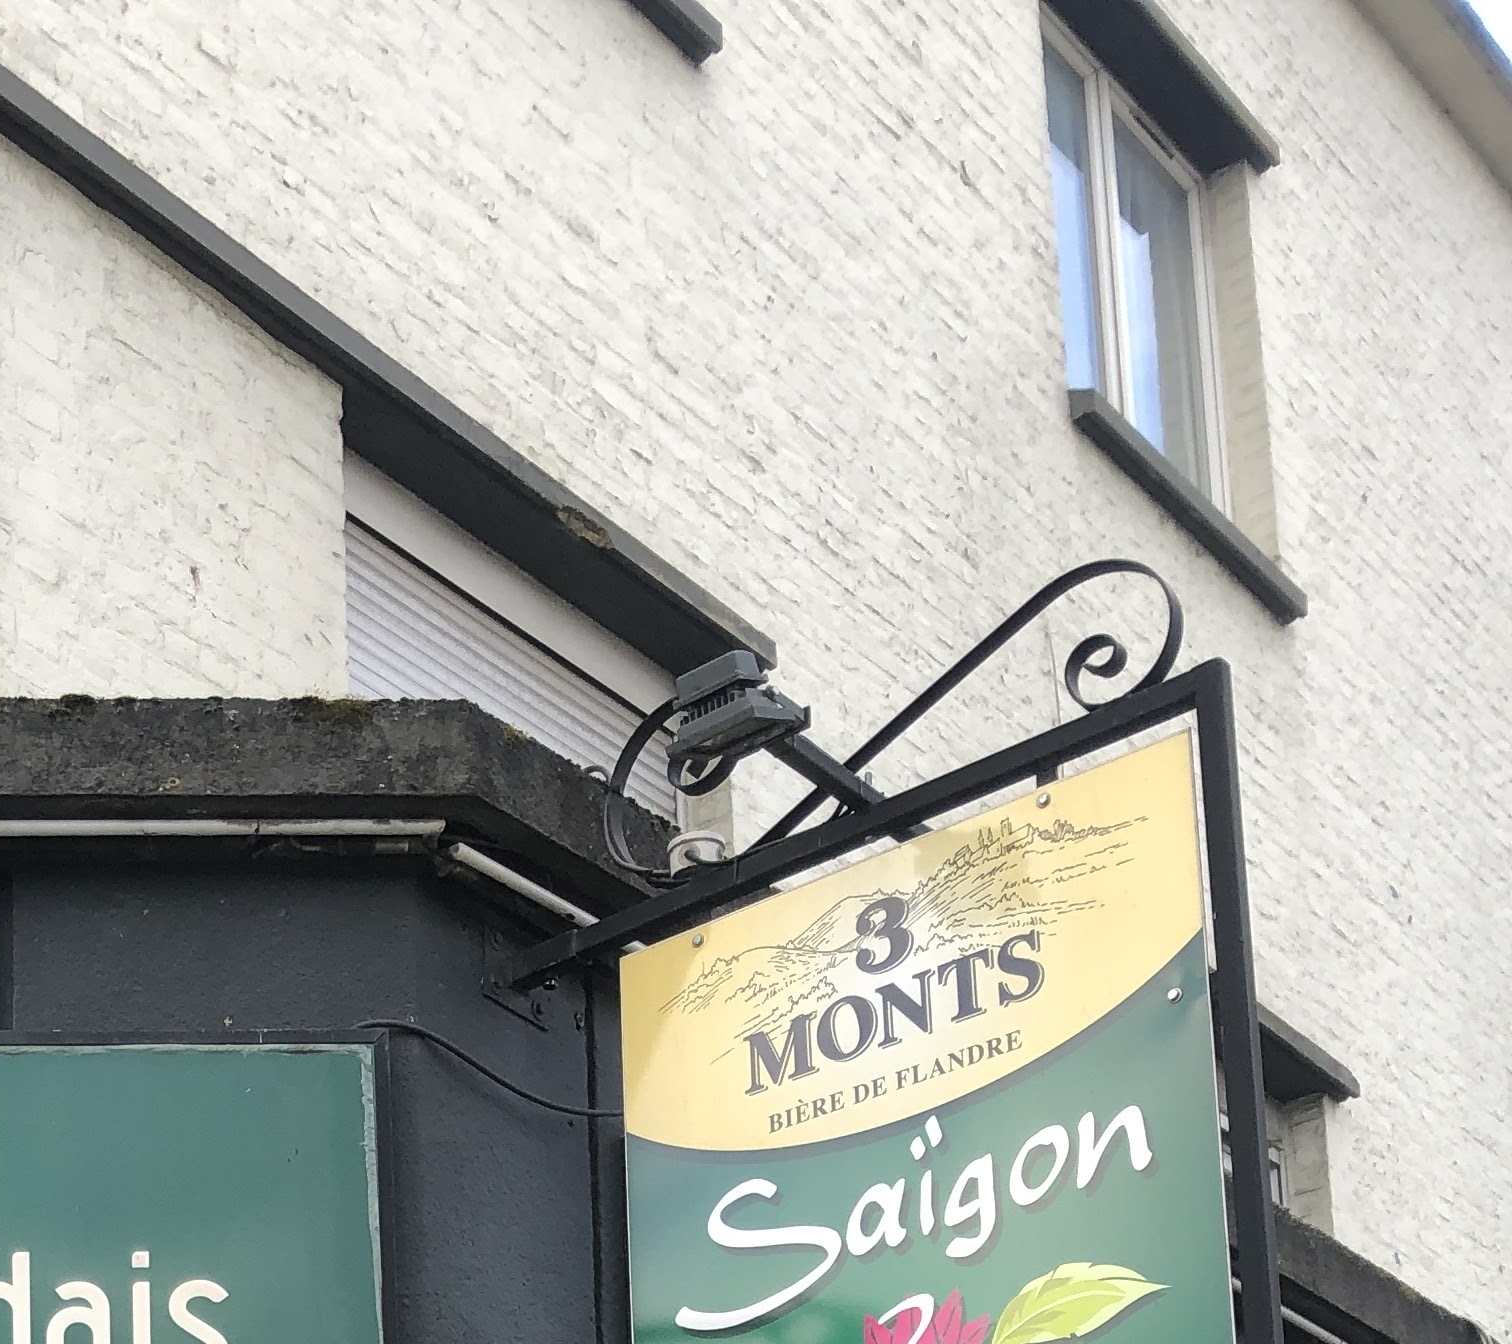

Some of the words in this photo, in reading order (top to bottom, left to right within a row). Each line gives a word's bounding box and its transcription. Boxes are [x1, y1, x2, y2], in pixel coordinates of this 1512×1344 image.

[856, 896, 915, 975] 3
[743, 928, 1046, 1096] MONTS
[768, 1090, 845, 1135] BIÈRE
[853, 1076, 888, 1106] DE
[895, 1029, 1024, 1091] FLANDRE
[674, 1104, 1154, 1331] Saïgon
